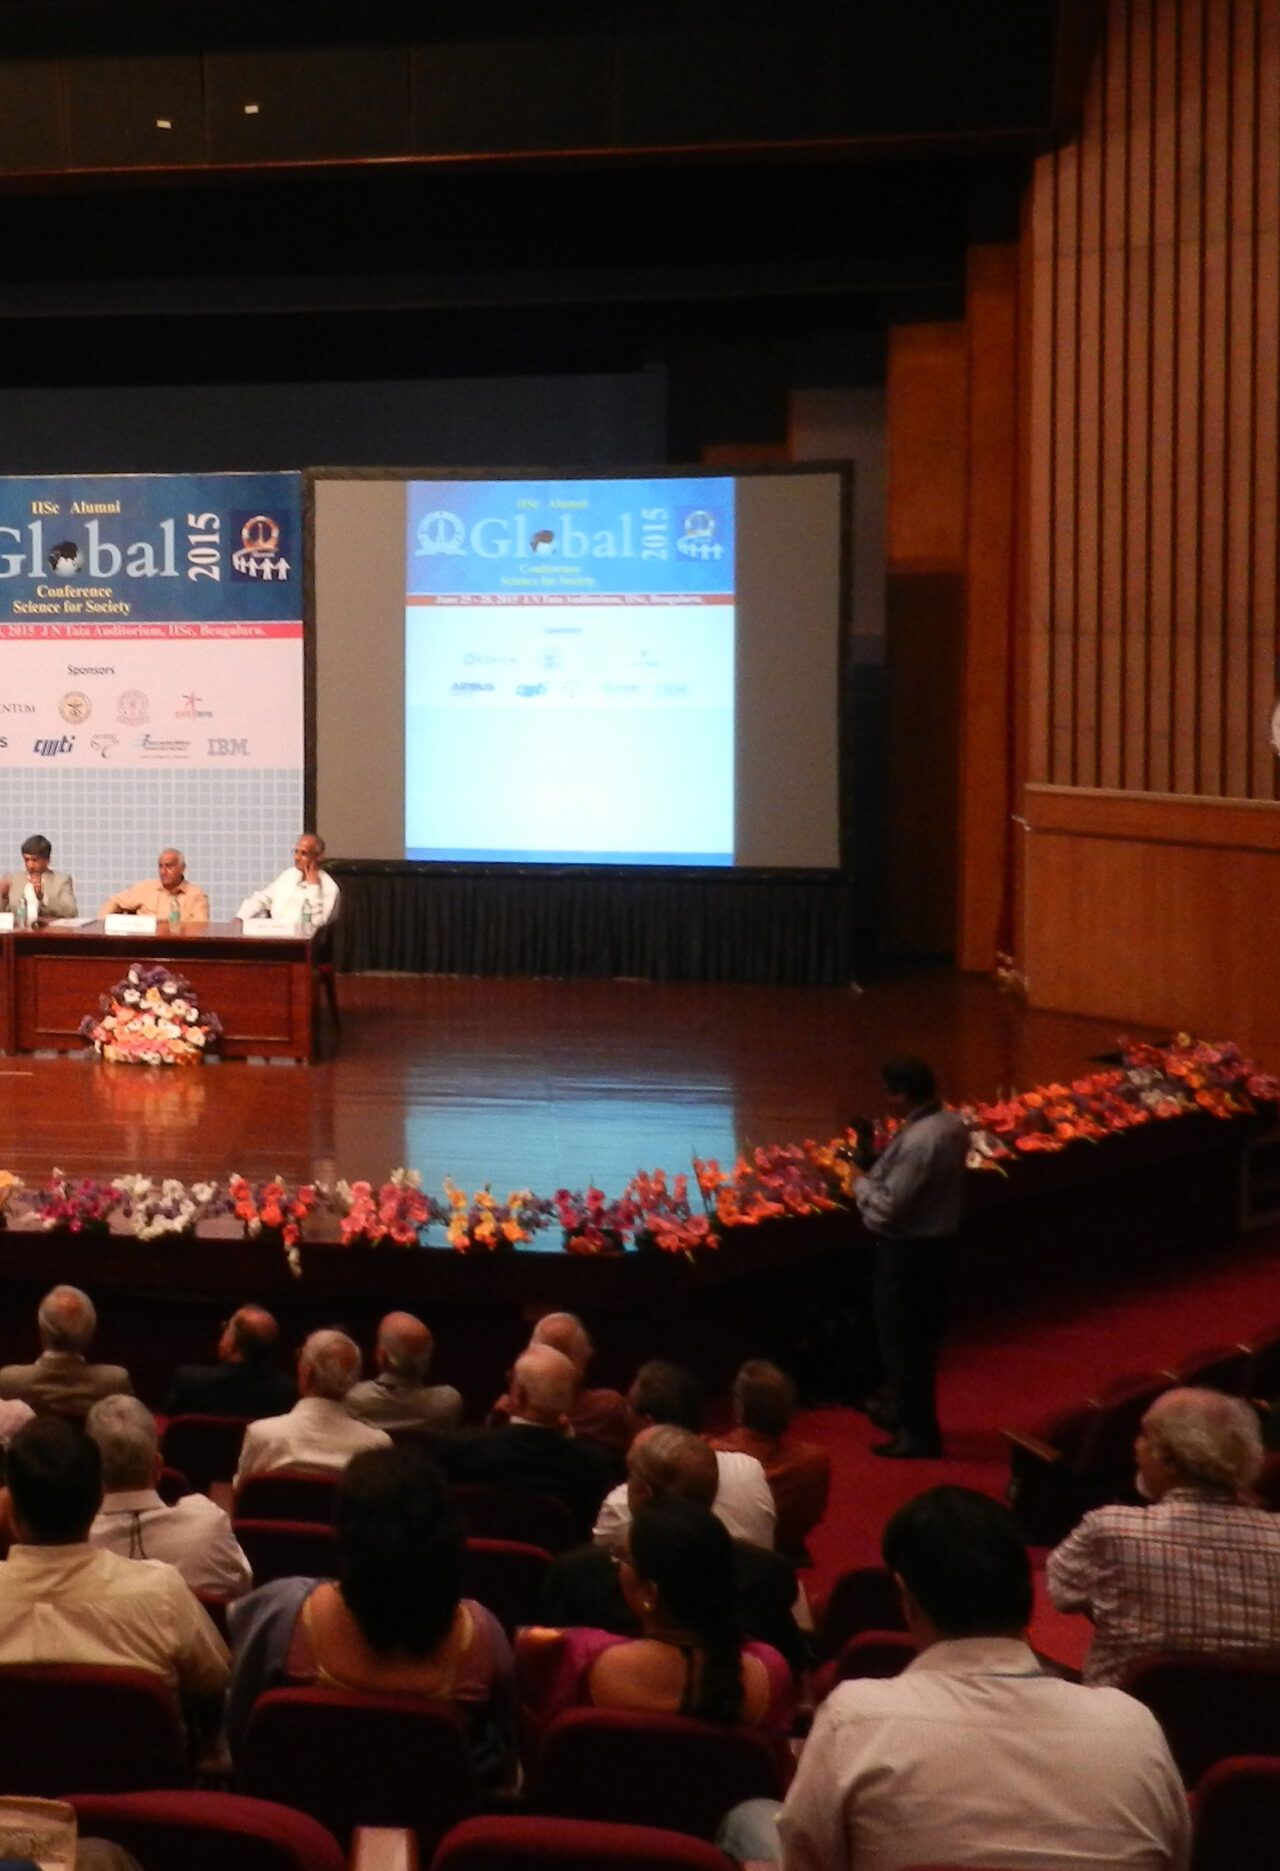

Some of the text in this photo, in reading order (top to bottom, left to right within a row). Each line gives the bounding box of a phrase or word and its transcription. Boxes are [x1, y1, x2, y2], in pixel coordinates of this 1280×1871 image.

[31, 500, 121, 515] IISc Alumni
[641, 508, 668, 560] 2015
[187, 512, 220, 582] 2015
[36, 584, 113, 598] Conference
[13, 600, 132, 616] Science for Society
[67, 664, 115, 676] Sponsors
[207, 738, 251, 756] IBM
